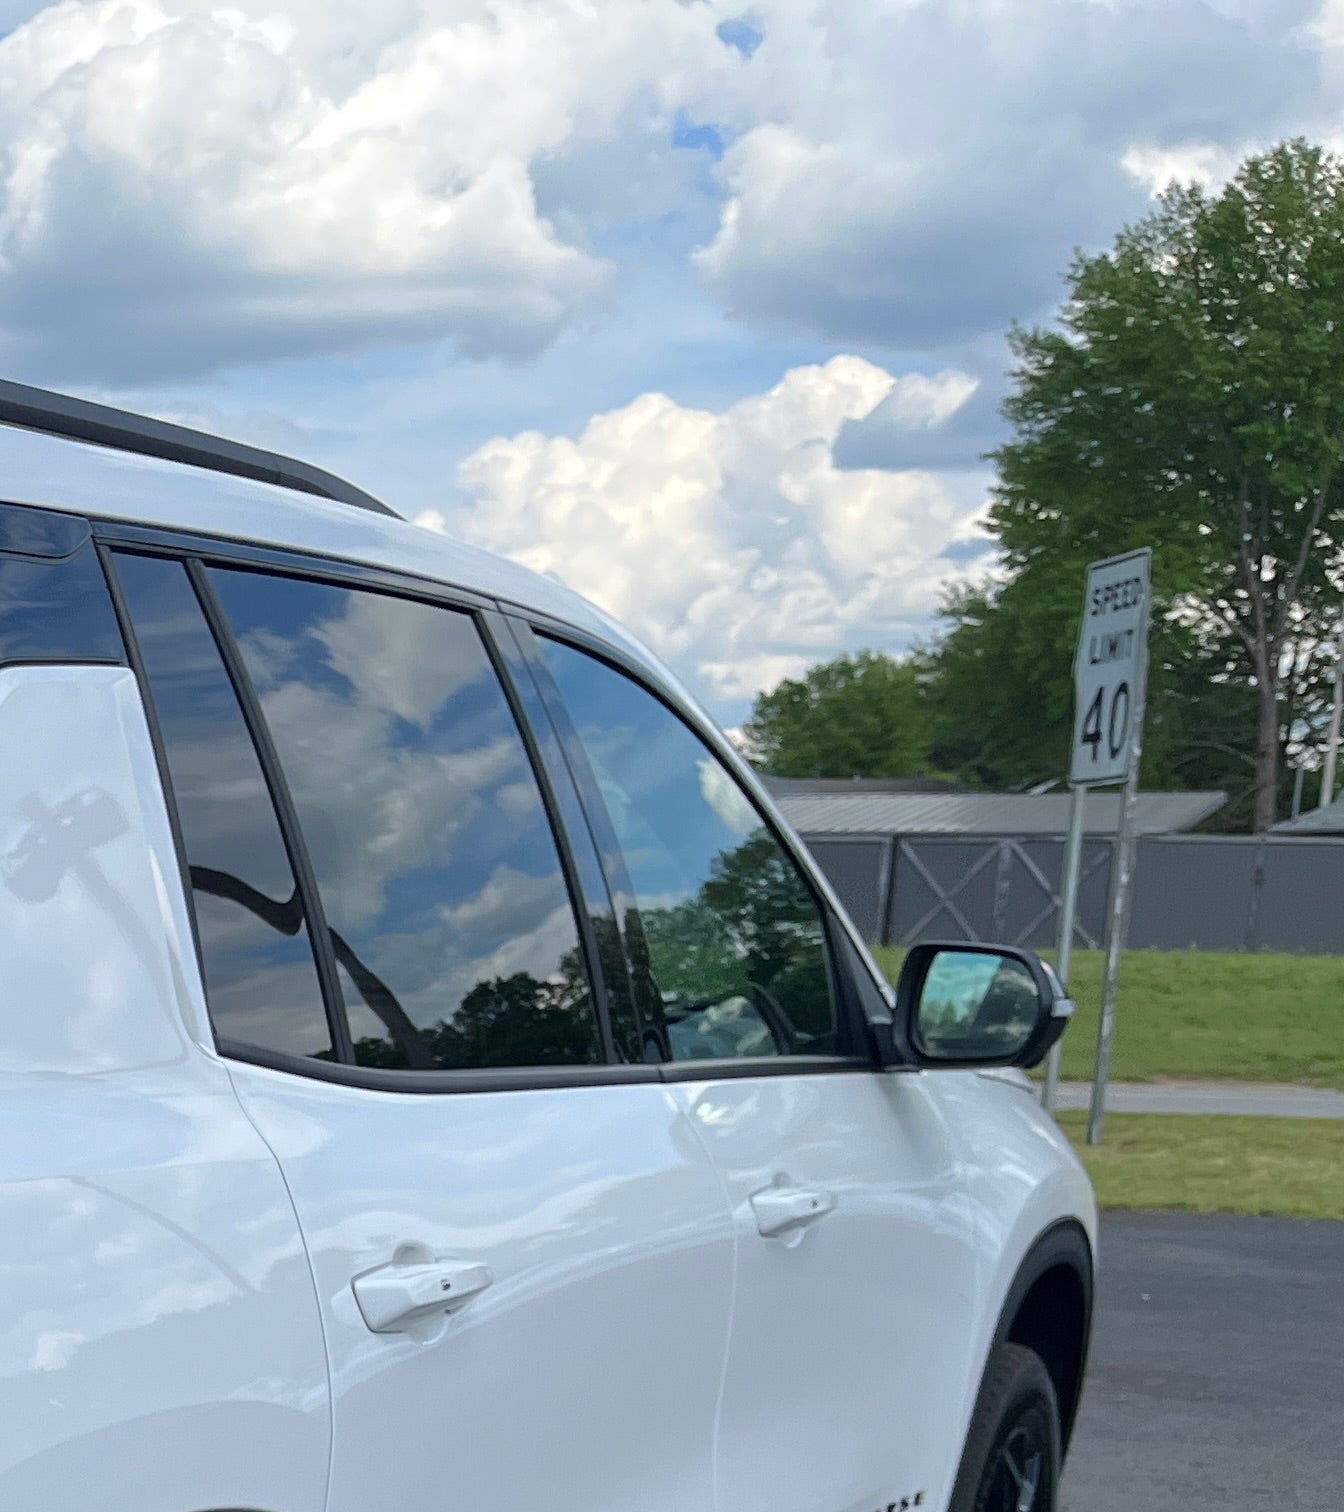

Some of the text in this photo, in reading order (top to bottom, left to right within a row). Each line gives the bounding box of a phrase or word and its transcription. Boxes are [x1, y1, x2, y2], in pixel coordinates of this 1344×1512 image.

[1090, 575, 1144, 618] SPEED
[1089, 628, 1135, 665] LIMIT
[1081, 681, 1129, 763] 40
